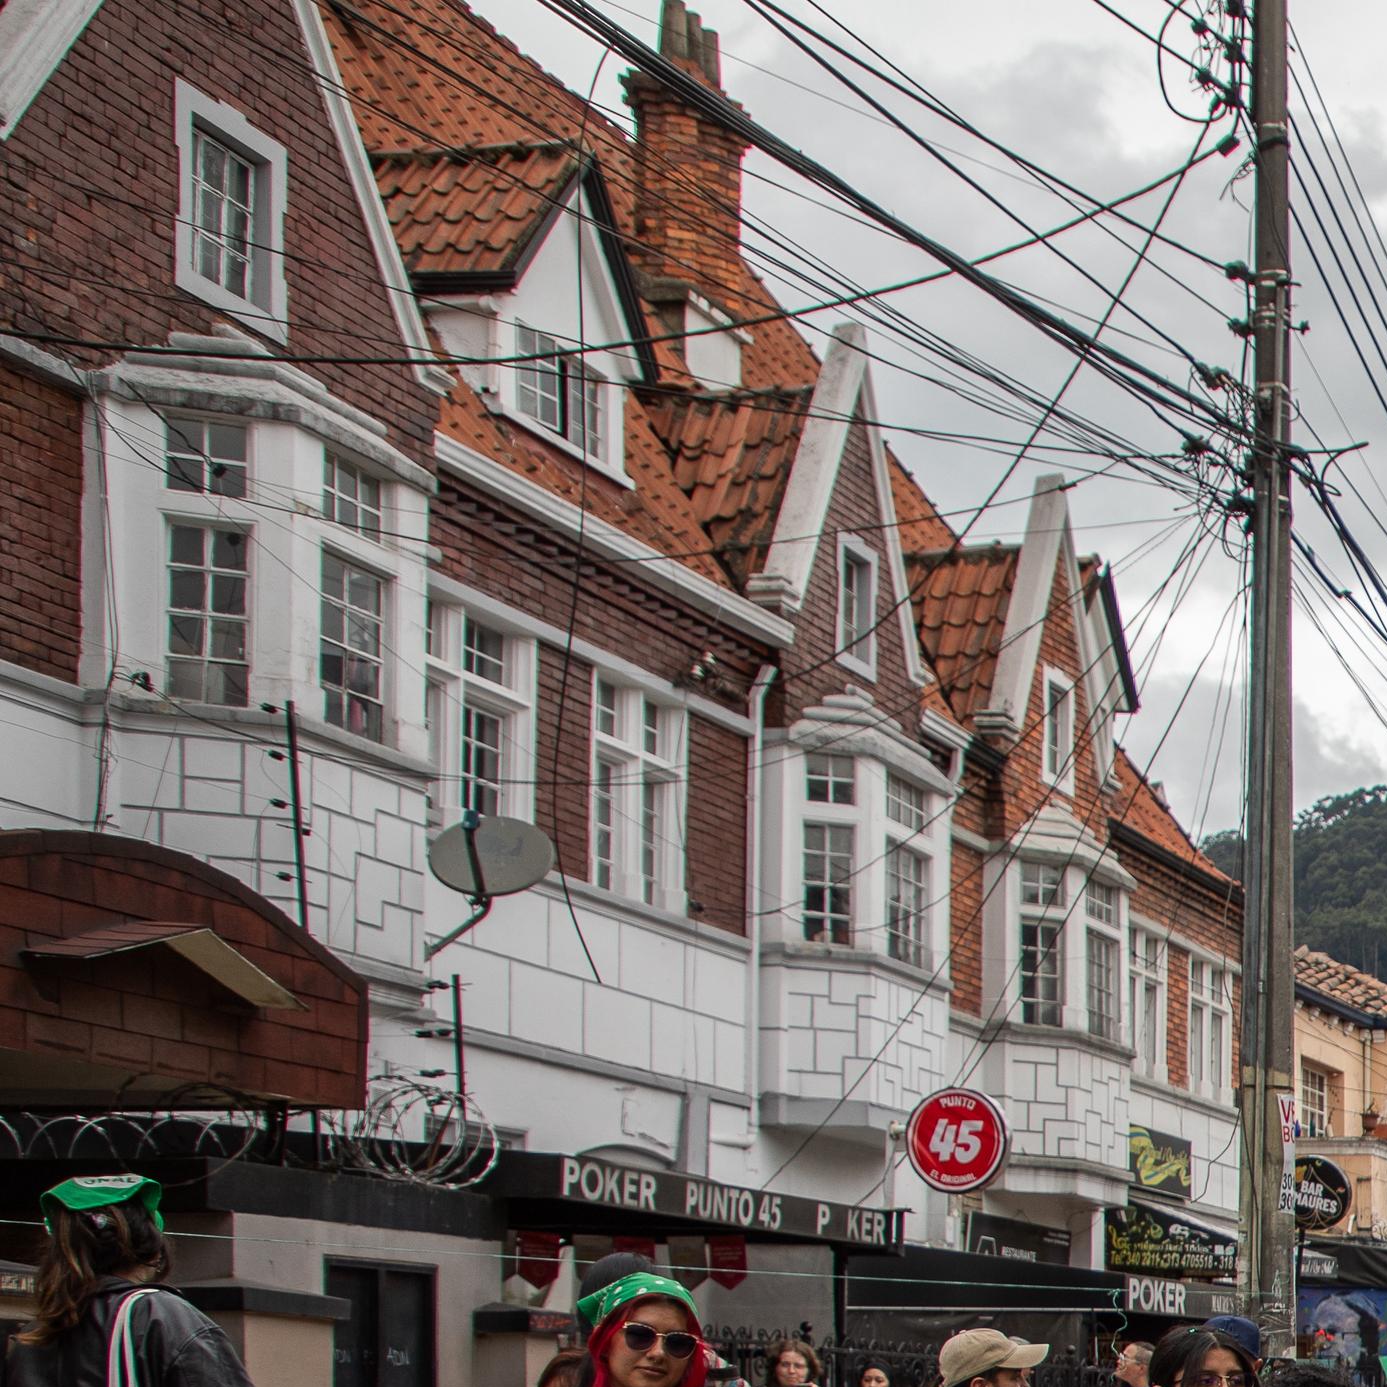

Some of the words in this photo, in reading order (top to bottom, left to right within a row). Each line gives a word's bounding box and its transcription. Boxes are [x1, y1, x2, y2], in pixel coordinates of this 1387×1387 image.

[939, 1096, 976, 1110] PUNTO
[929, 1118, 984, 1164] 45
[561, 1157, 656, 1211] POKER
[1301, 1180, 1323, 1197] BAR
[685, 1181, 754, 1227] PUNTO
[758, 1194, 782, 1230] 45
[1128, 1277, 1186, 1315] POKER
